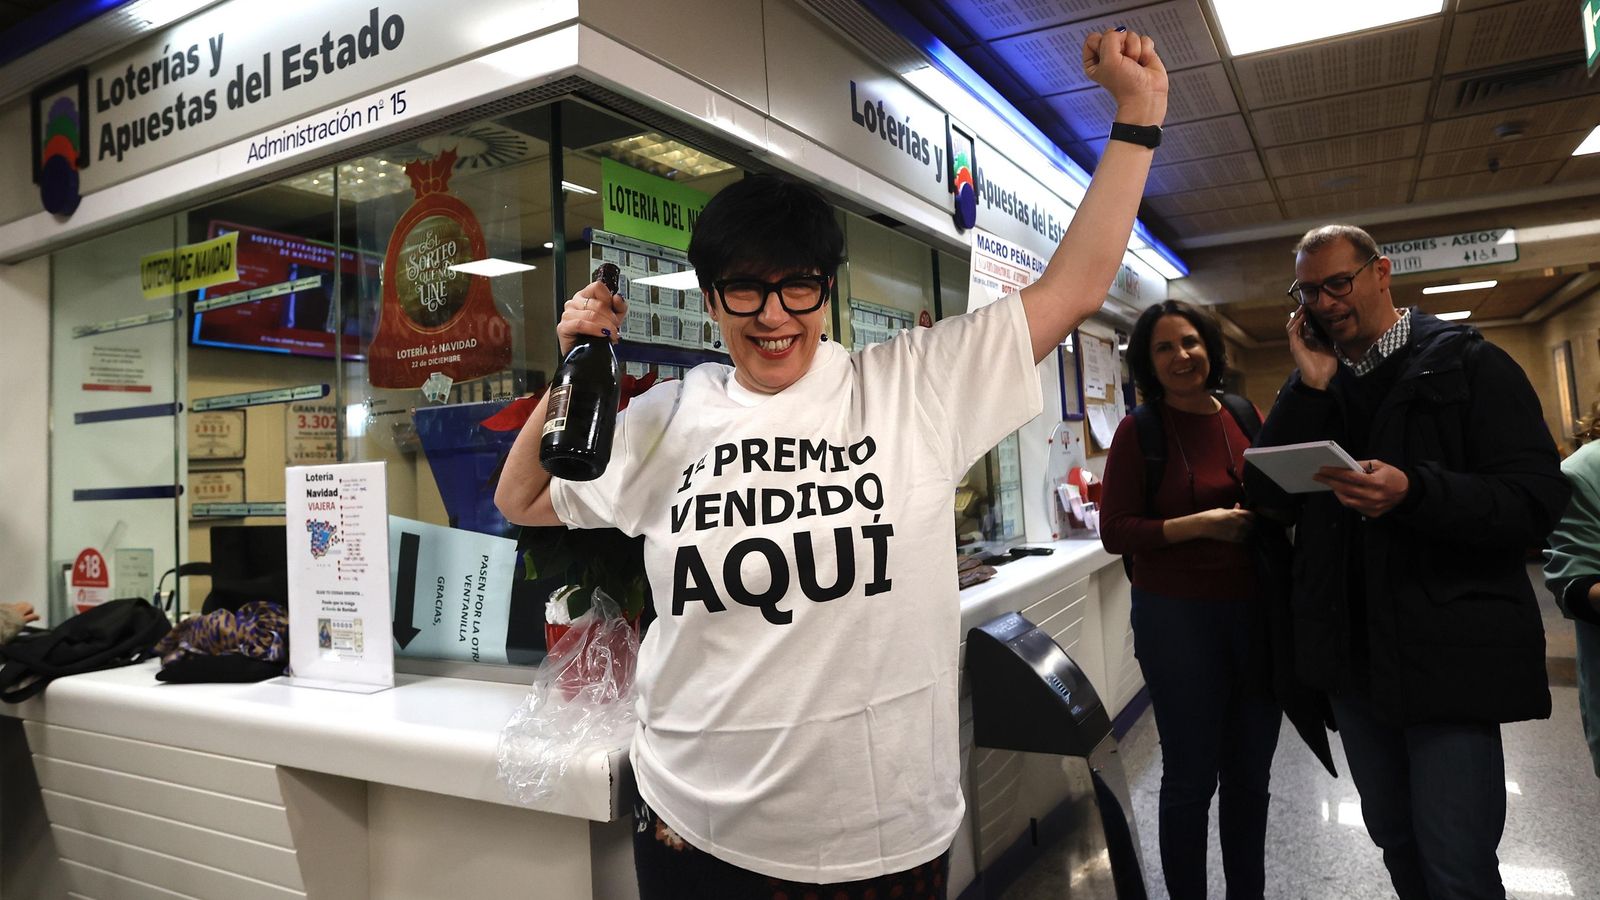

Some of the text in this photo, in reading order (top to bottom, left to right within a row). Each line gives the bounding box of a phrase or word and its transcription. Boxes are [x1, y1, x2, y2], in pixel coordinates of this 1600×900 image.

[96, 32, 224, 113] Loterías y
[98, 6, 405, 162] Apuestas del Estado
[247, 108, 362, 164] Administración
[390, 90, 407, 116] 15
[849, 80, 944, 184] Loterías y
[608, 182, 660, 224] LOTERIA
[662, 199, 685, 231] DEL
[977, 166, 1066, 244] Apuestas del Est
[251, 233, 285, 248] SORTEO
[280, 248, 328, 264] DE NAVIDAD
[976, 233, 1008, 259] MACRO
[1010, 248, 1031, 271] PEÑA
[1381, 238, 1438, 256] NSORES
[1450, 230, 1499, 248] ASEOS
[141, 241, 232, 291] LOTERIA DE NAVIDAD
[396, 344, 429, 360] LOTERÍA
[438, 338, 478, 354] NAVIDAD
[411, 354, 462, 369] 22 de DICIEMBRE
[713, 435, 877, 477] PREMIO
[306, 487, 339, 499] Navidad
[308, 501, 336, 512] VIAJERA
[671, 472, 884, 534] VENDIDO
[79, 554, 101, 579] +18
[671, 513, 895, 626] AQUÍ
[458, 574, 473, 643] VENTANILLA
[471, 554, 489, 663] PASEN POR LA OTR
